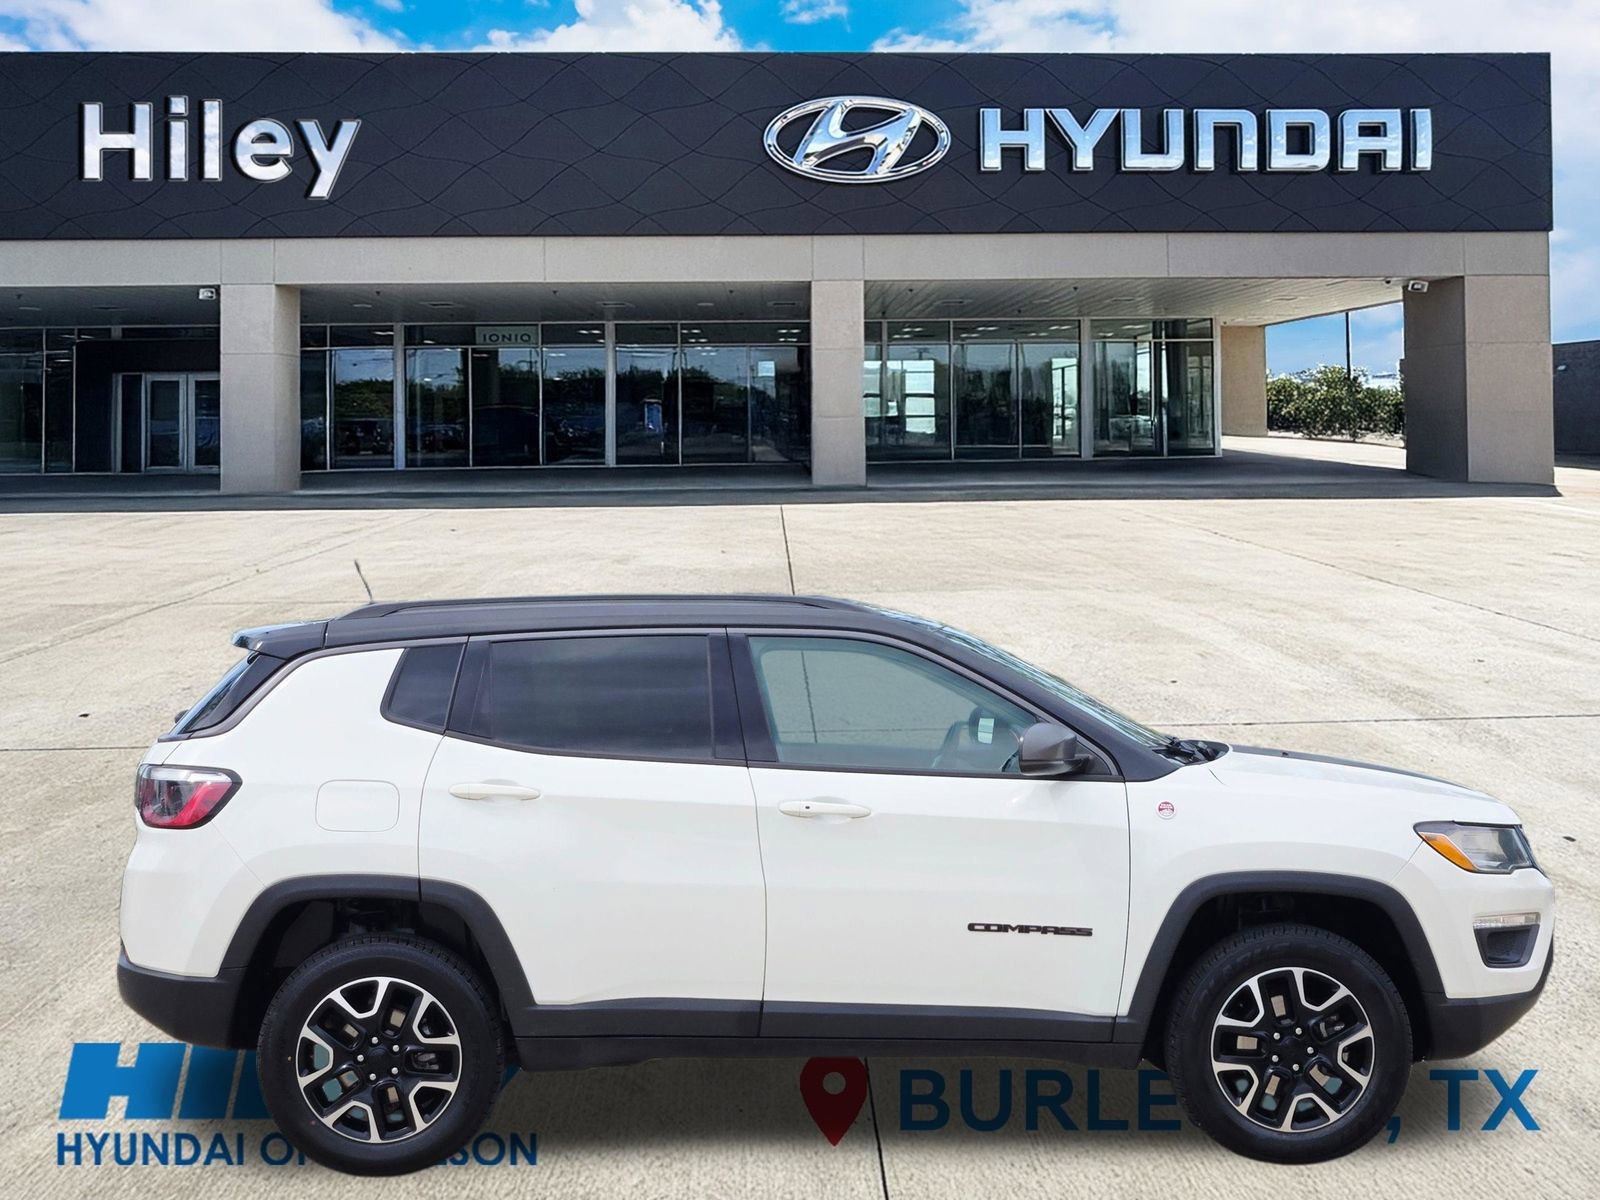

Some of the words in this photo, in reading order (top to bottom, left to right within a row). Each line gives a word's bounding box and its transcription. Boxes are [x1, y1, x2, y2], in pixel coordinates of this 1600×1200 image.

[80, 95, 362, 200] Hiley
[979, 107, 1432, 172] HYUNDAI
[967, 922, 1093, 937] COMPASS
